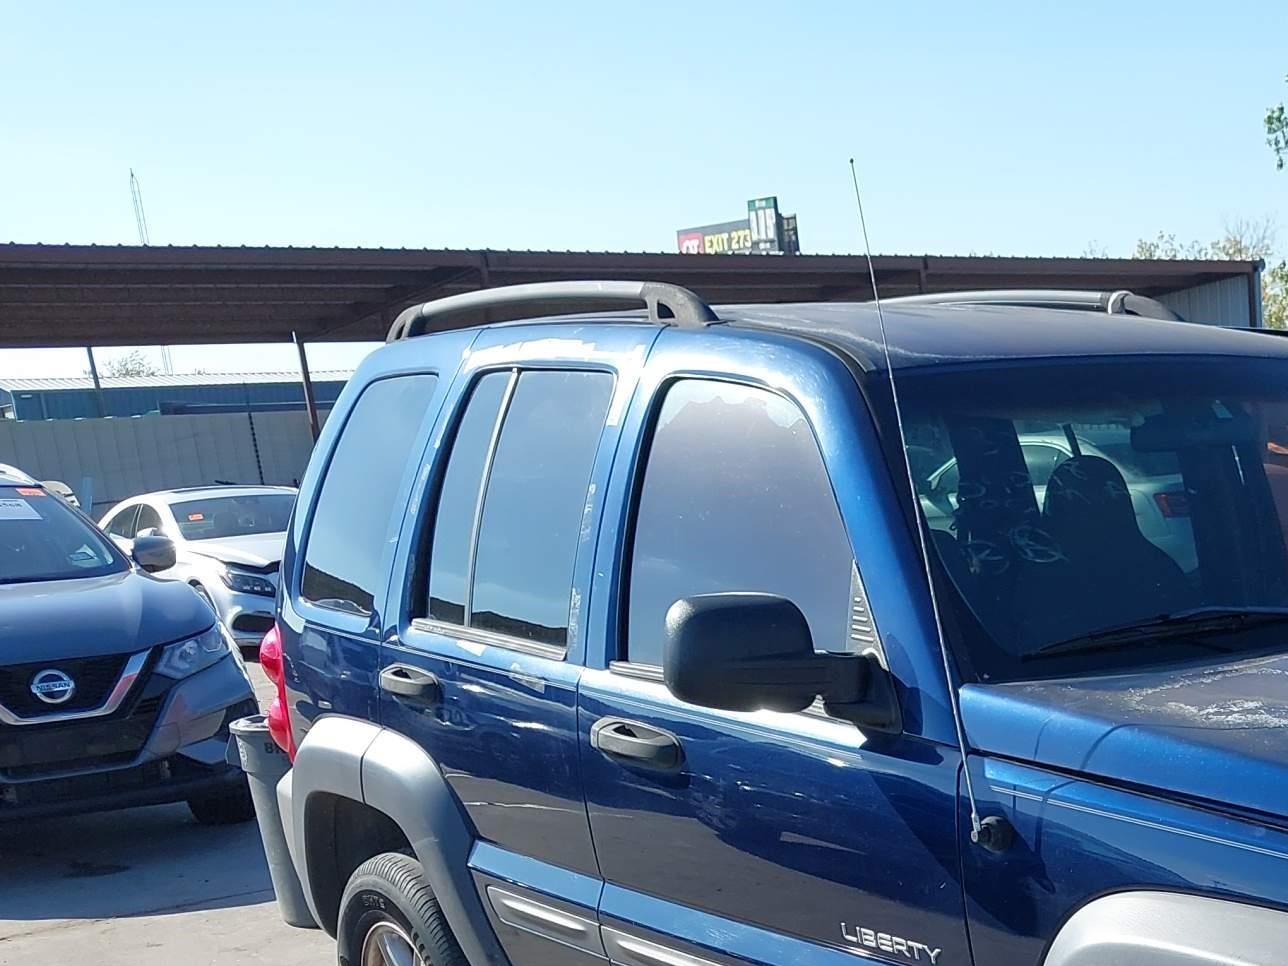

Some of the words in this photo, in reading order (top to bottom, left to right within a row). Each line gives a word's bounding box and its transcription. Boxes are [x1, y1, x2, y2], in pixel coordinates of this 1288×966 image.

[704, 233, 729, 254] EXIT
[731, 229, 752, 250] 273
[36, 681, 70, 692] NISSAN
[841, 922, 942, 965] LIBERTY
